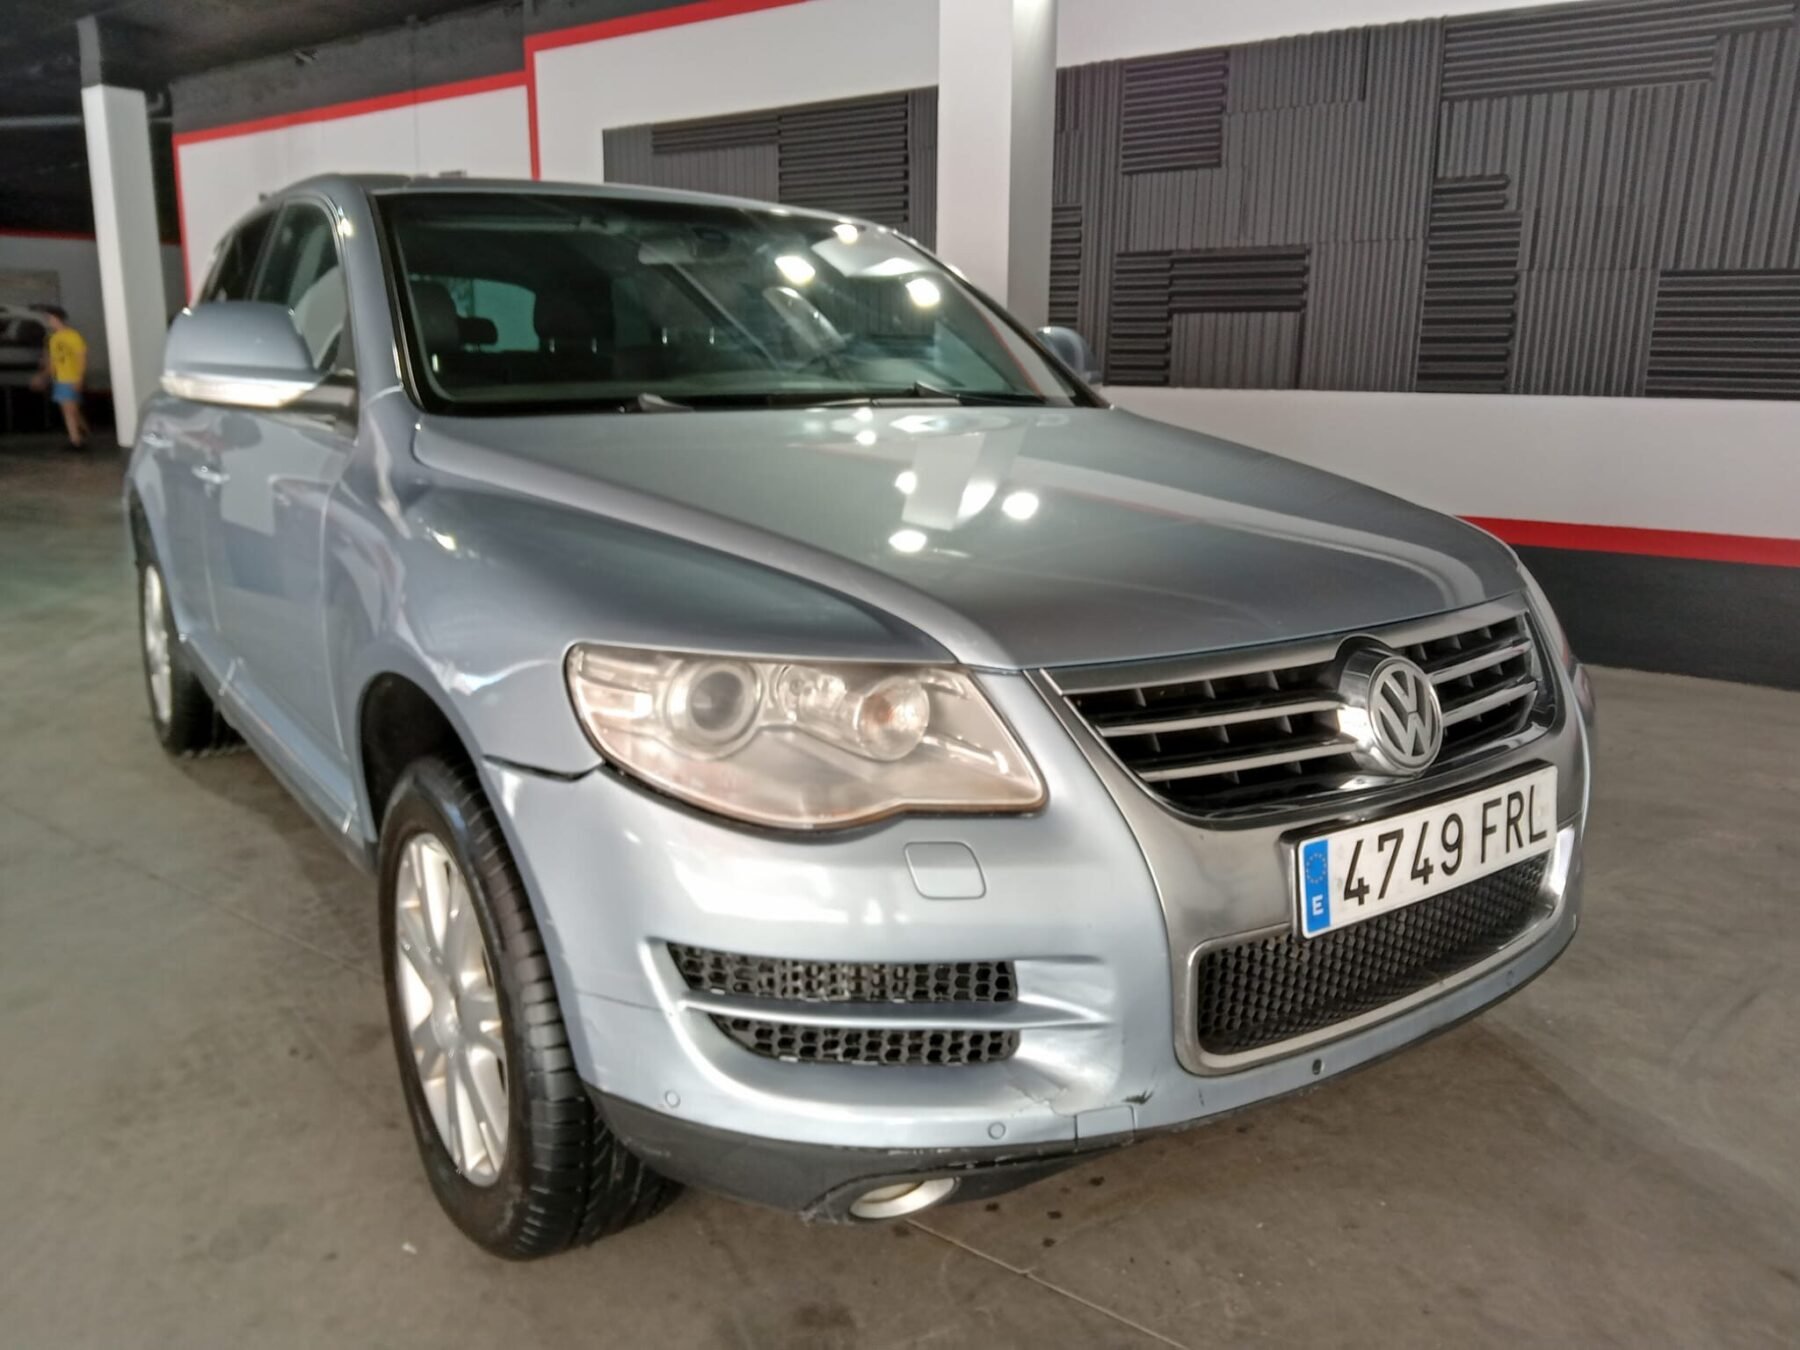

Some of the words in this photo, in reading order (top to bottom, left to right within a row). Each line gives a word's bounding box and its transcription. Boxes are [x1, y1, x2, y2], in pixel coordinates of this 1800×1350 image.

[1373, 662, 1438, 766] VW
[1343, 812, 1464, 906] 4749
[1480, 784, 1548, 864] FRL
[1311, 894, 1324, 917] E
